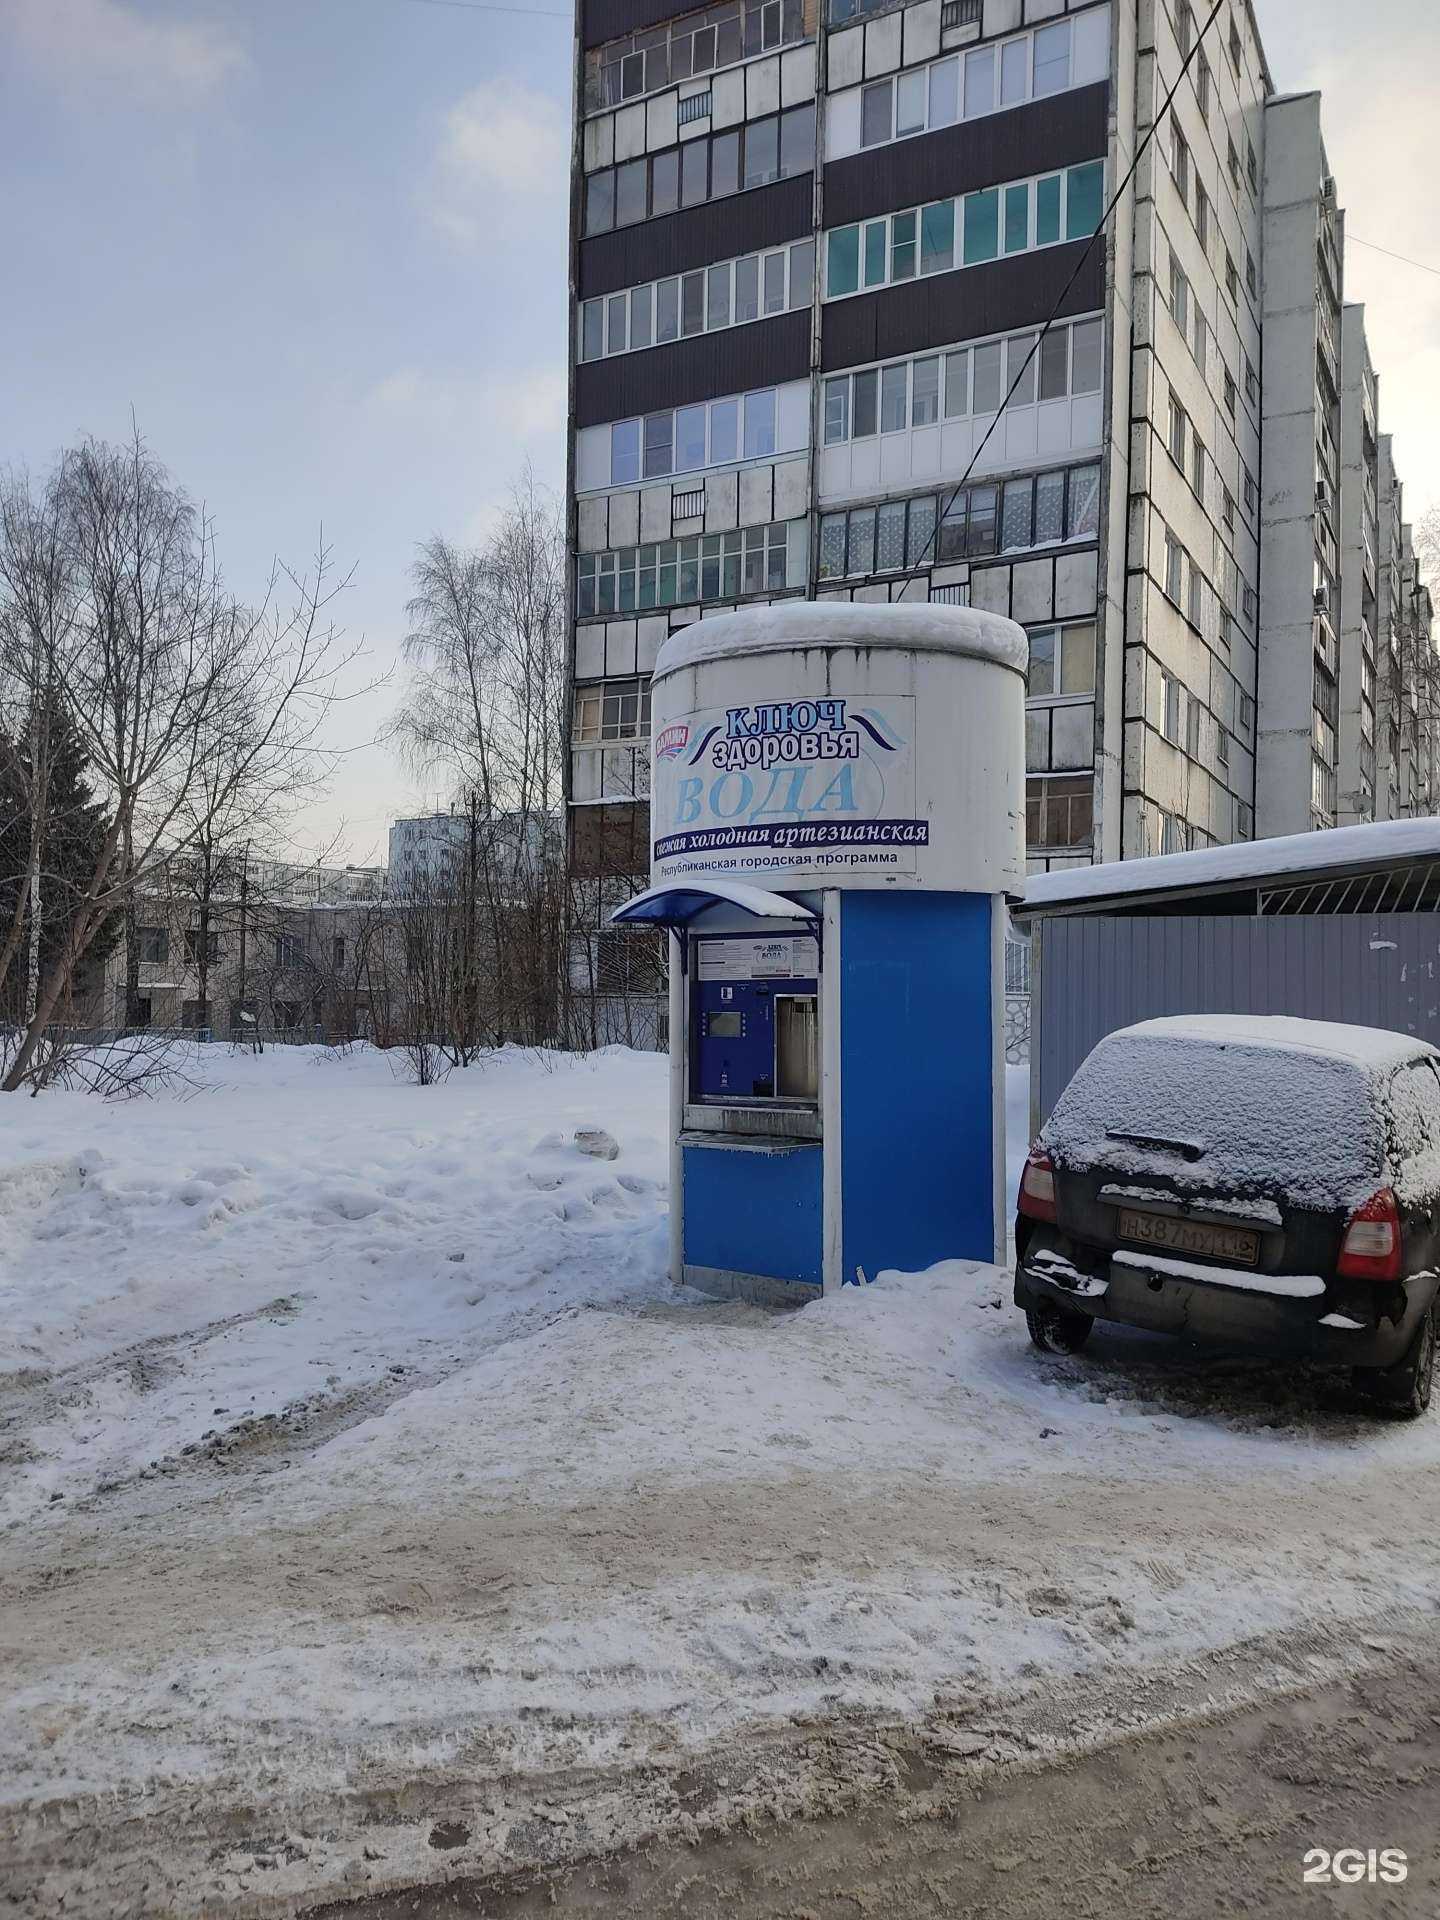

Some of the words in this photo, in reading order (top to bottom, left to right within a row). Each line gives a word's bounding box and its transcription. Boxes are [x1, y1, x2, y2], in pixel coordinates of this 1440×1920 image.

[726, 700, 846, 739] КЛЮЧ
[674, 763, 858, 825] ВОДА
[656, 837, 686, 857] свежая
[689, 826, 769, 849] холодная
[773, 824, 927, 848] артезианская
[661, 858, 737, 877] Республиканская
[741, 854, 812, 869] городская
[816, 853, 898, 866] программа
